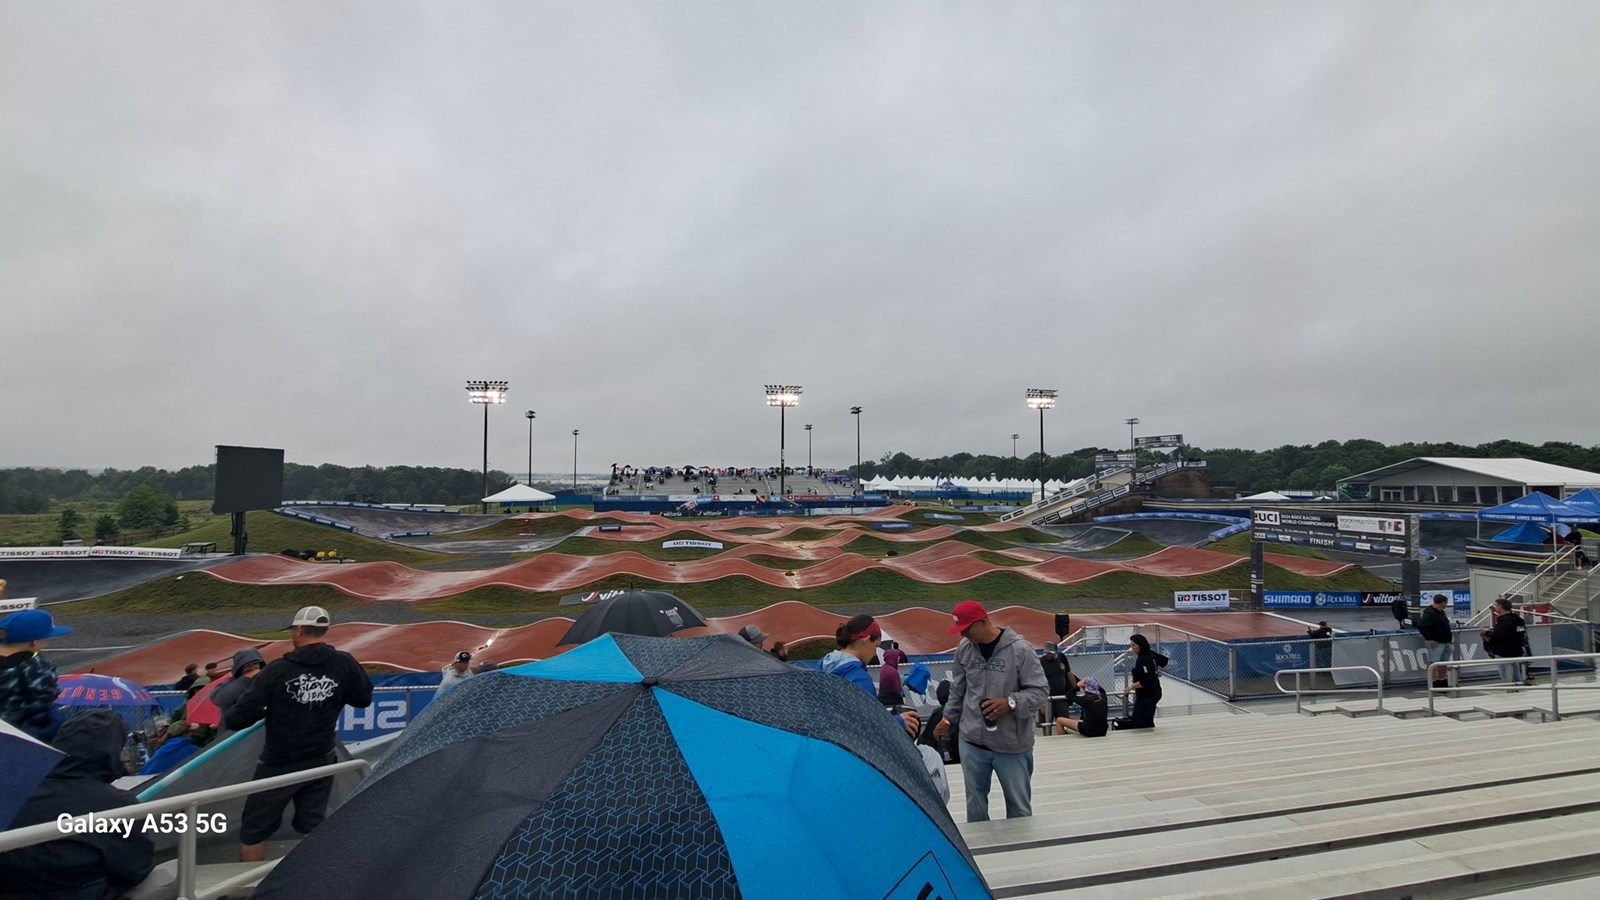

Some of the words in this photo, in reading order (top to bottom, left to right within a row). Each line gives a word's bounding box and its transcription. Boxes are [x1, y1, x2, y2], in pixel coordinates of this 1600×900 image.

[1259, 513, 1278, 523] UCI
[1309, 537, 1334, 546] FINISH
[1191, 593, 1227, 602] TISSOT
[1263, 594, 1312, 604] SHIMANO
[1373, 593, 1402, 604] vittori
[0, 603, 31, 611] SSOT
